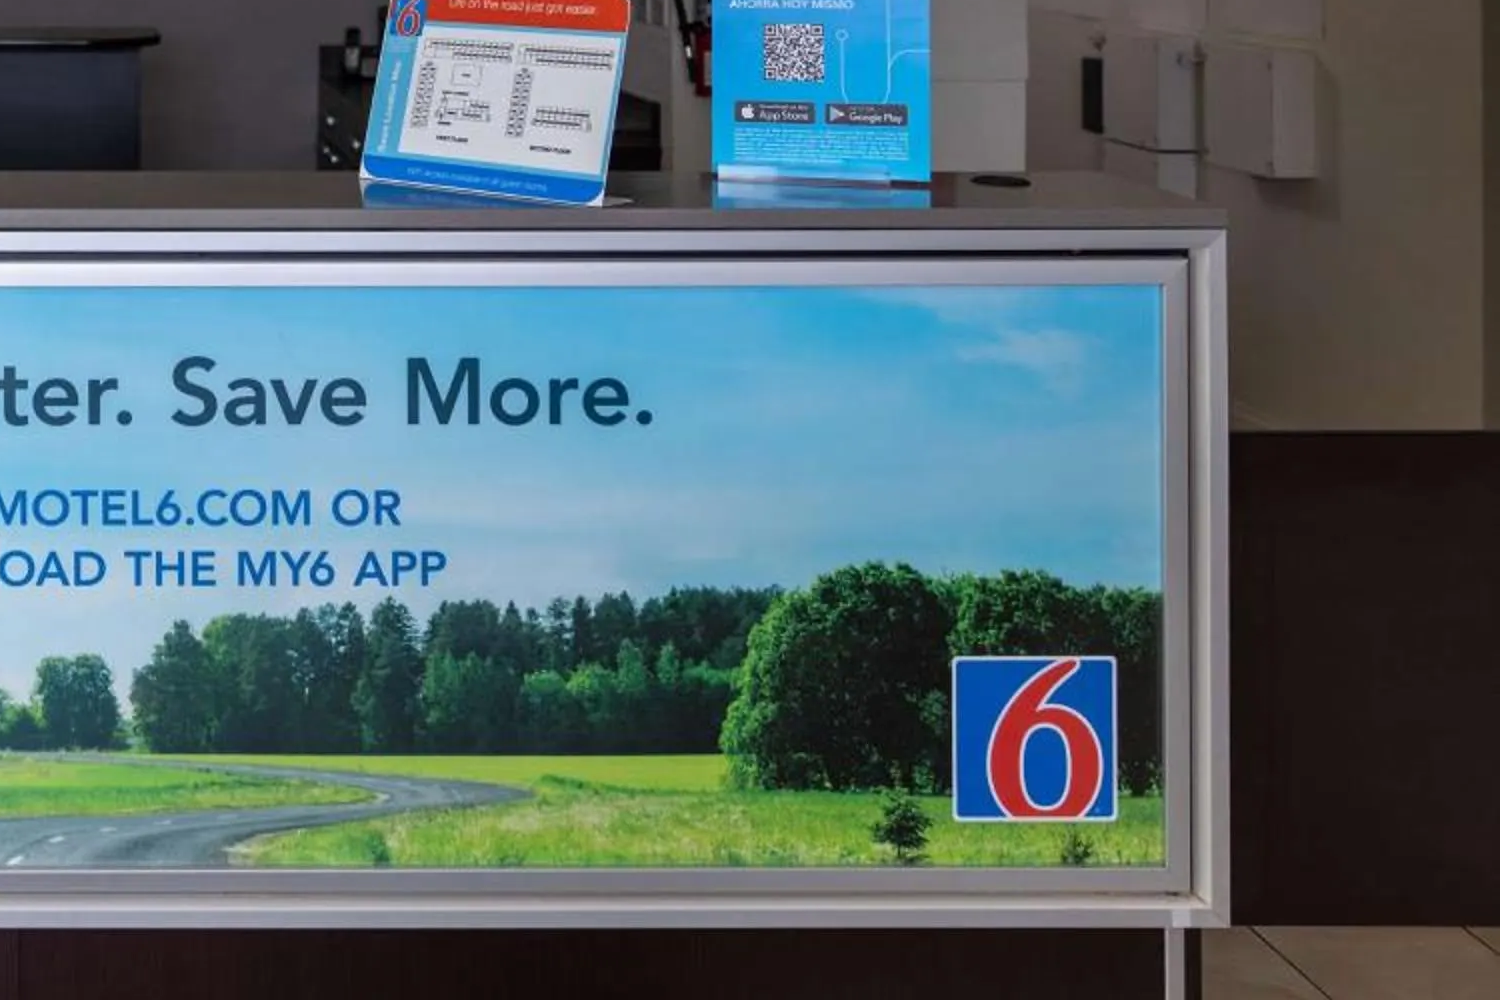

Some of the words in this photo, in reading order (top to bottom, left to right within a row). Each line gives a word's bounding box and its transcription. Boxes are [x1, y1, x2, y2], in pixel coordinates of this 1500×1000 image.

[468, 0, 480, 9] on
[760, 109, 780, 122] App
[781, 109, 808, 120] Store
[849, 112, 882, 124] Google
[884, 112, 902, 125] Play
[171, 355, 367, 427] Save
[407, 357, 653, 427] More.
[331, 489, 401, 526] OR
[124, 550, 216, 587] THE
[237, 550, 335, 587] MY6
[353, 550, 447, 587] APP
[986, 656, 1104, 821] 6
